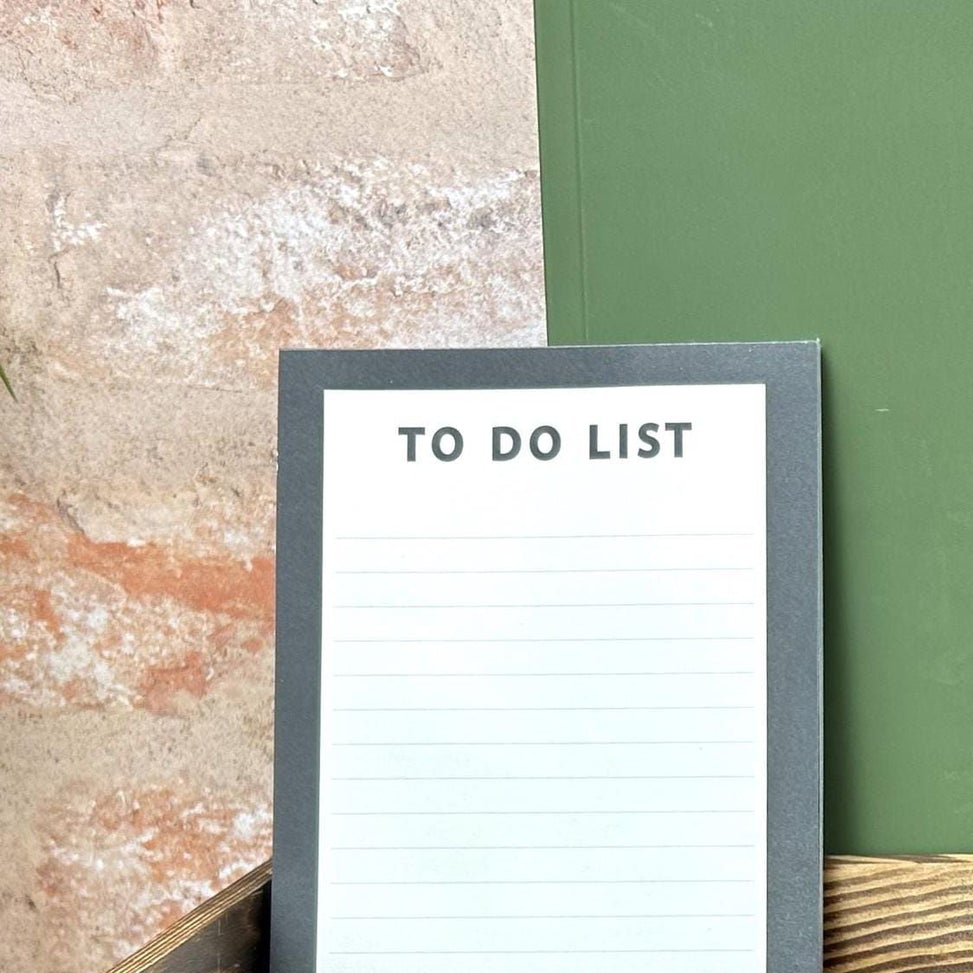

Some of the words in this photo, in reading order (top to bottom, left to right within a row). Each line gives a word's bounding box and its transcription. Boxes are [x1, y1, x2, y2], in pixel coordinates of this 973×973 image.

[398, 426, 464, 462] TO
[492, 425, 561, 461] DO
[589, 422, 692, 460] LIST
